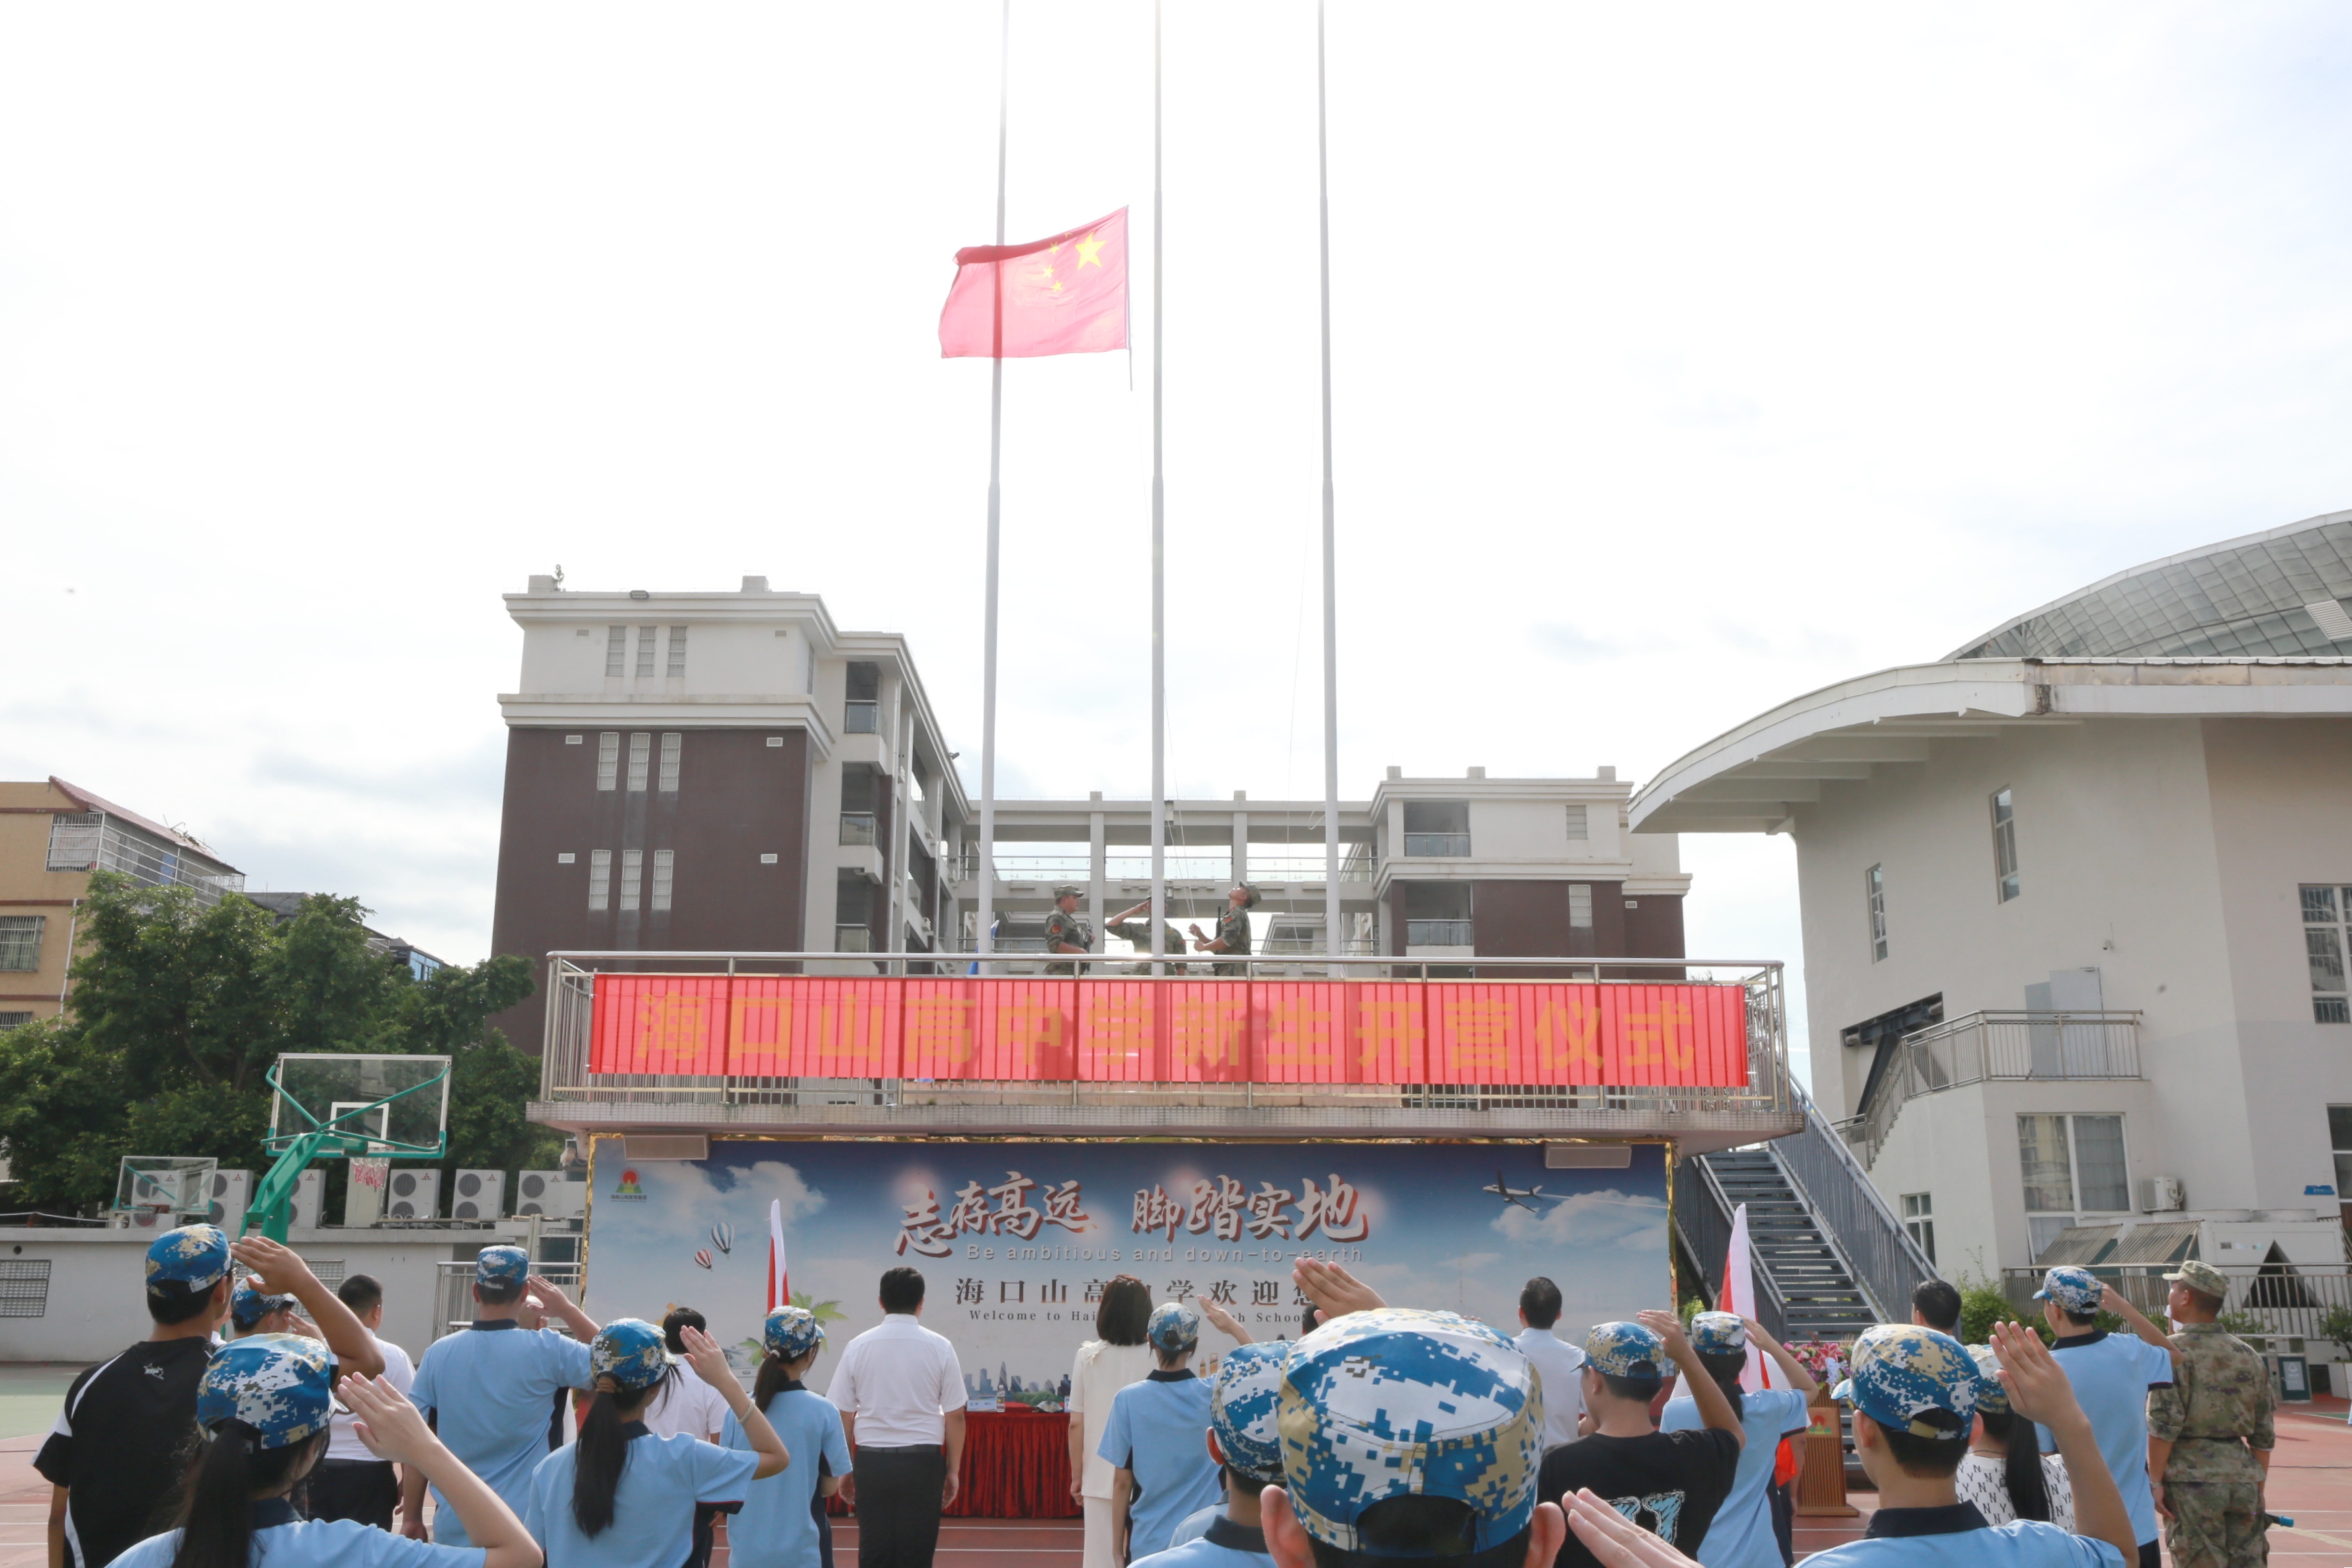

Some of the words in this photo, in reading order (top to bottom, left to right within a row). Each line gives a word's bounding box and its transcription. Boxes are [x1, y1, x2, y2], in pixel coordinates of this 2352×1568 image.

[637, 991, 1695, 1071] 海口山高中学新生开营仪式
[893, 1171, 1098, 1259] 志存高远
[1131, 1173, 1368, 1243] 脚踏实地
[968, 1245, 995, 1260] Be
[1007, 1245, 1121, 1261] ambitious
[1134, 1247, 1173, 1262] and
[1186, 1247, 1363, 1262] down-to-earth
[956, 1277, 1312, 1306] 海口山高学欢迎
[970, 1310, 1036, 1321] Welcome
[1047, 1311, 1060, 1321] to
[1257, 1313, 1300, 1323] Schoo
